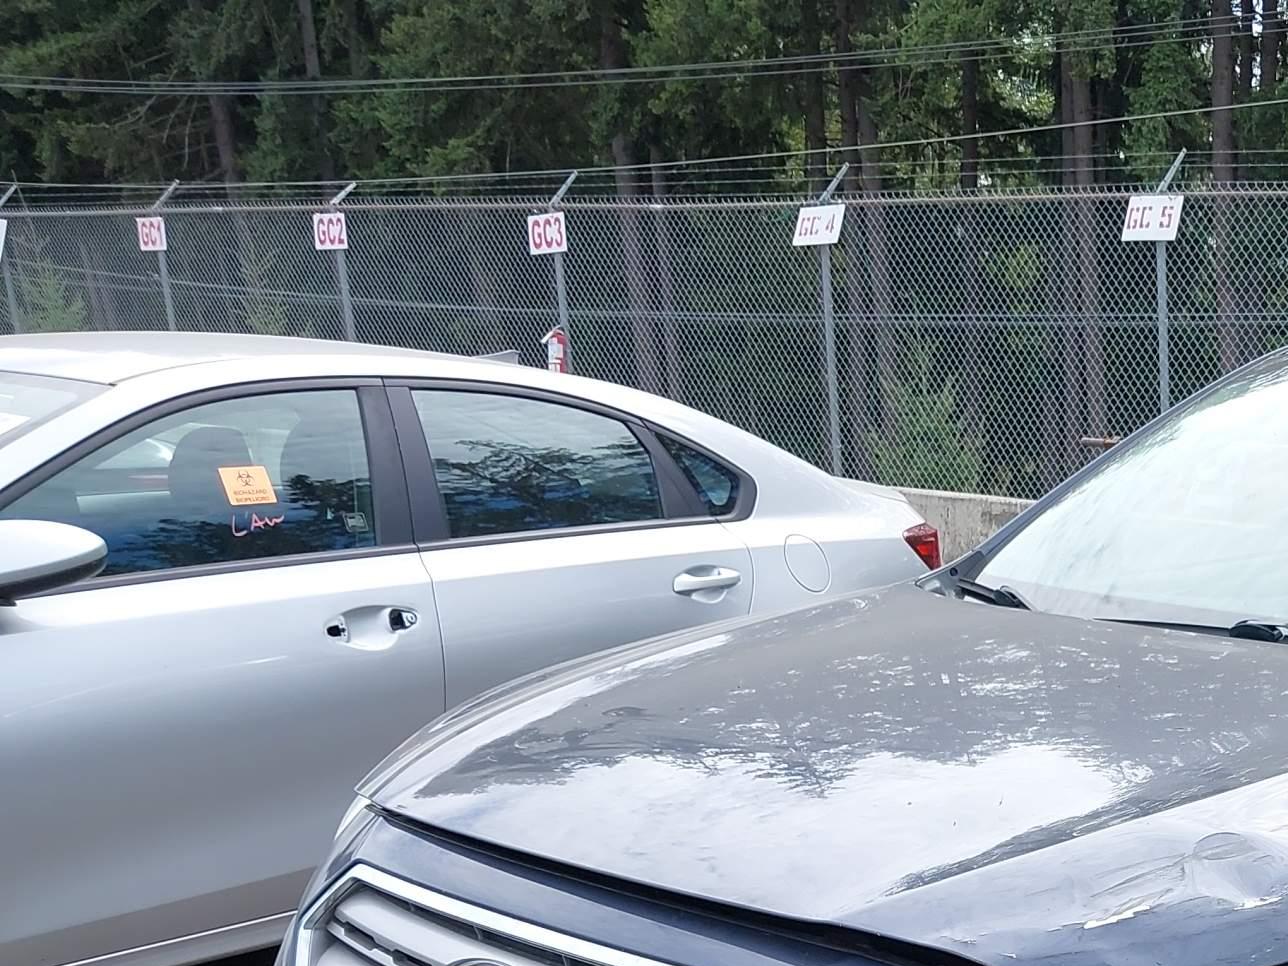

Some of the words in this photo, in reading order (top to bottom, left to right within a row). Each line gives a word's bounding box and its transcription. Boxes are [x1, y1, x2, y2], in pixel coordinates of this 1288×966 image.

[141, 221, 163, 247] GC1
[317, 217, 345, 246] GC2
[531, 216, 563, 249] GC3
